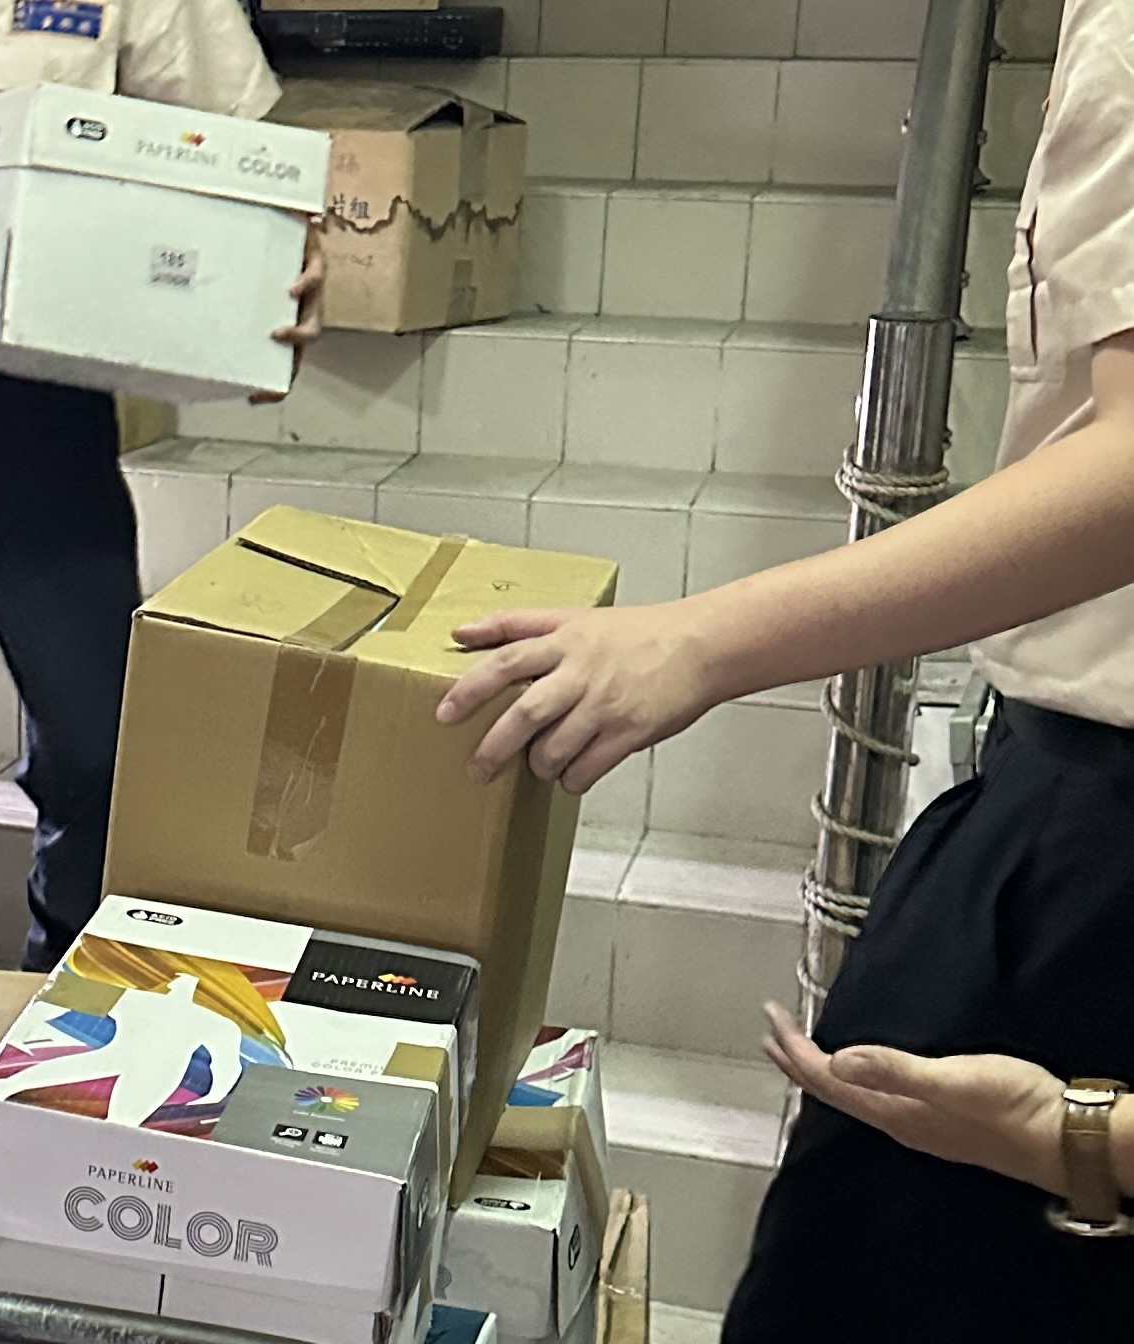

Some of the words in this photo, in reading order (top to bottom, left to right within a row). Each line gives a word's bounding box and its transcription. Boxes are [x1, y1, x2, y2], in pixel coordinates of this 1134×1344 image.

[238, 157, 302, 183] COLOR
[312, 970, 440, 1000] PAPERLINE
[88, 1164, 174, 1194] PAPERLINE
[65, 1185, 279, 1268] COLOR
